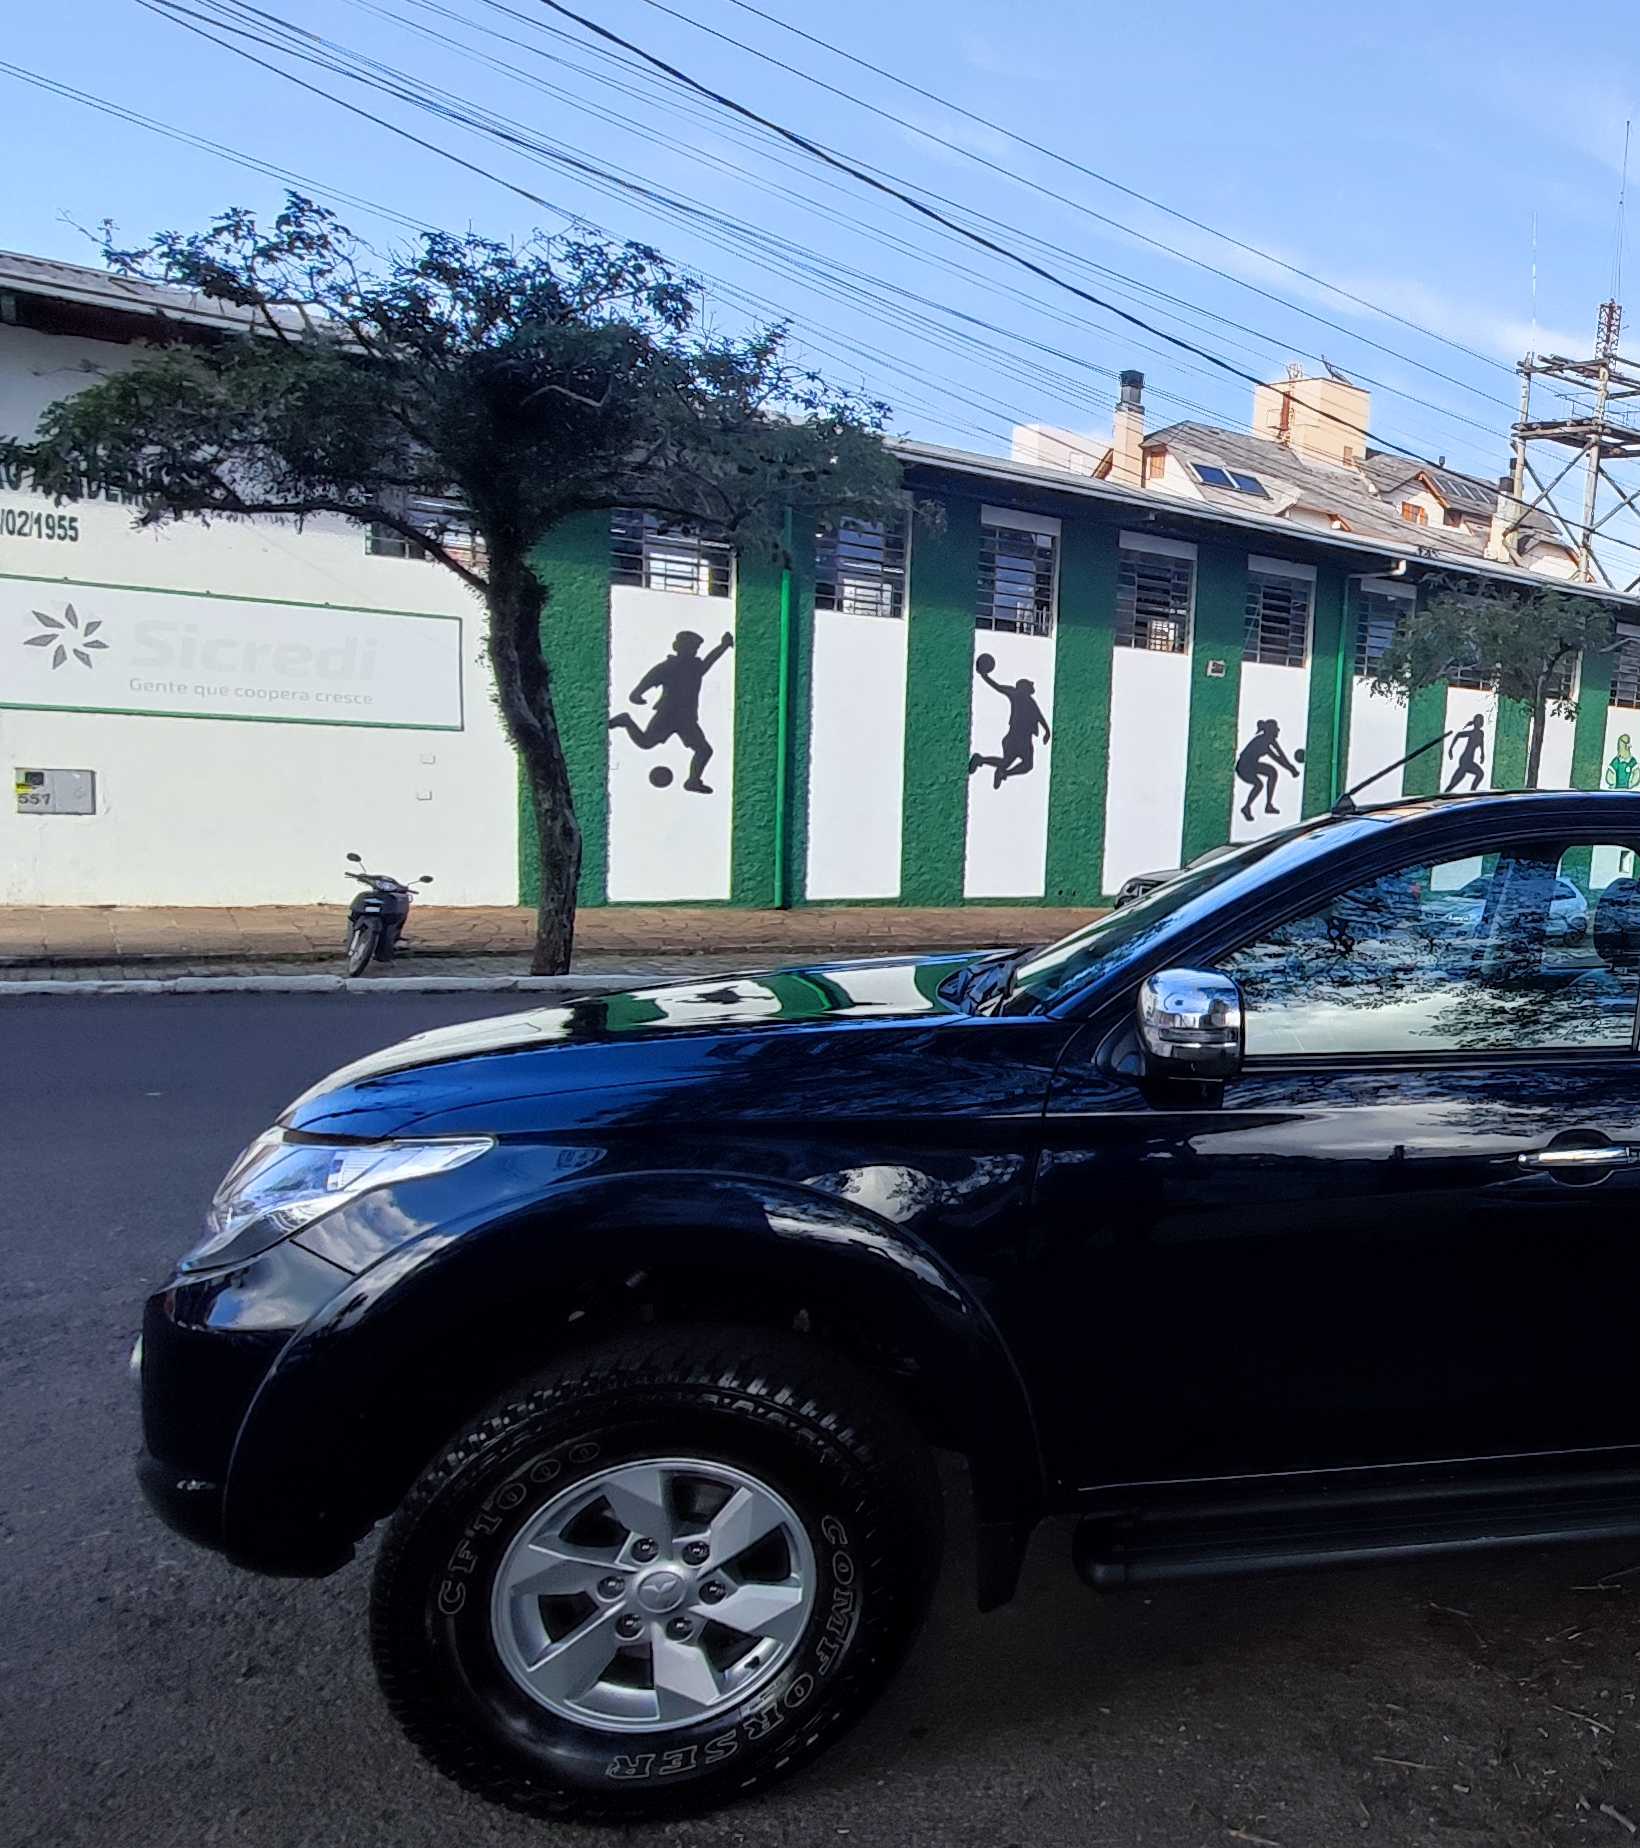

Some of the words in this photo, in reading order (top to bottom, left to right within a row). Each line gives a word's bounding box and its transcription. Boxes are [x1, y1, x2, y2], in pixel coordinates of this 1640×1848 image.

[129, 618, 378, 681] Sicredi
[129, 677, 189, 696] Gente
[193, 683, 230, 700] que
[234, 686, 310, 703] coopera
[315, 691, 375, 706] cresce
[604, 1514, 862, 1780] COMFORSER
